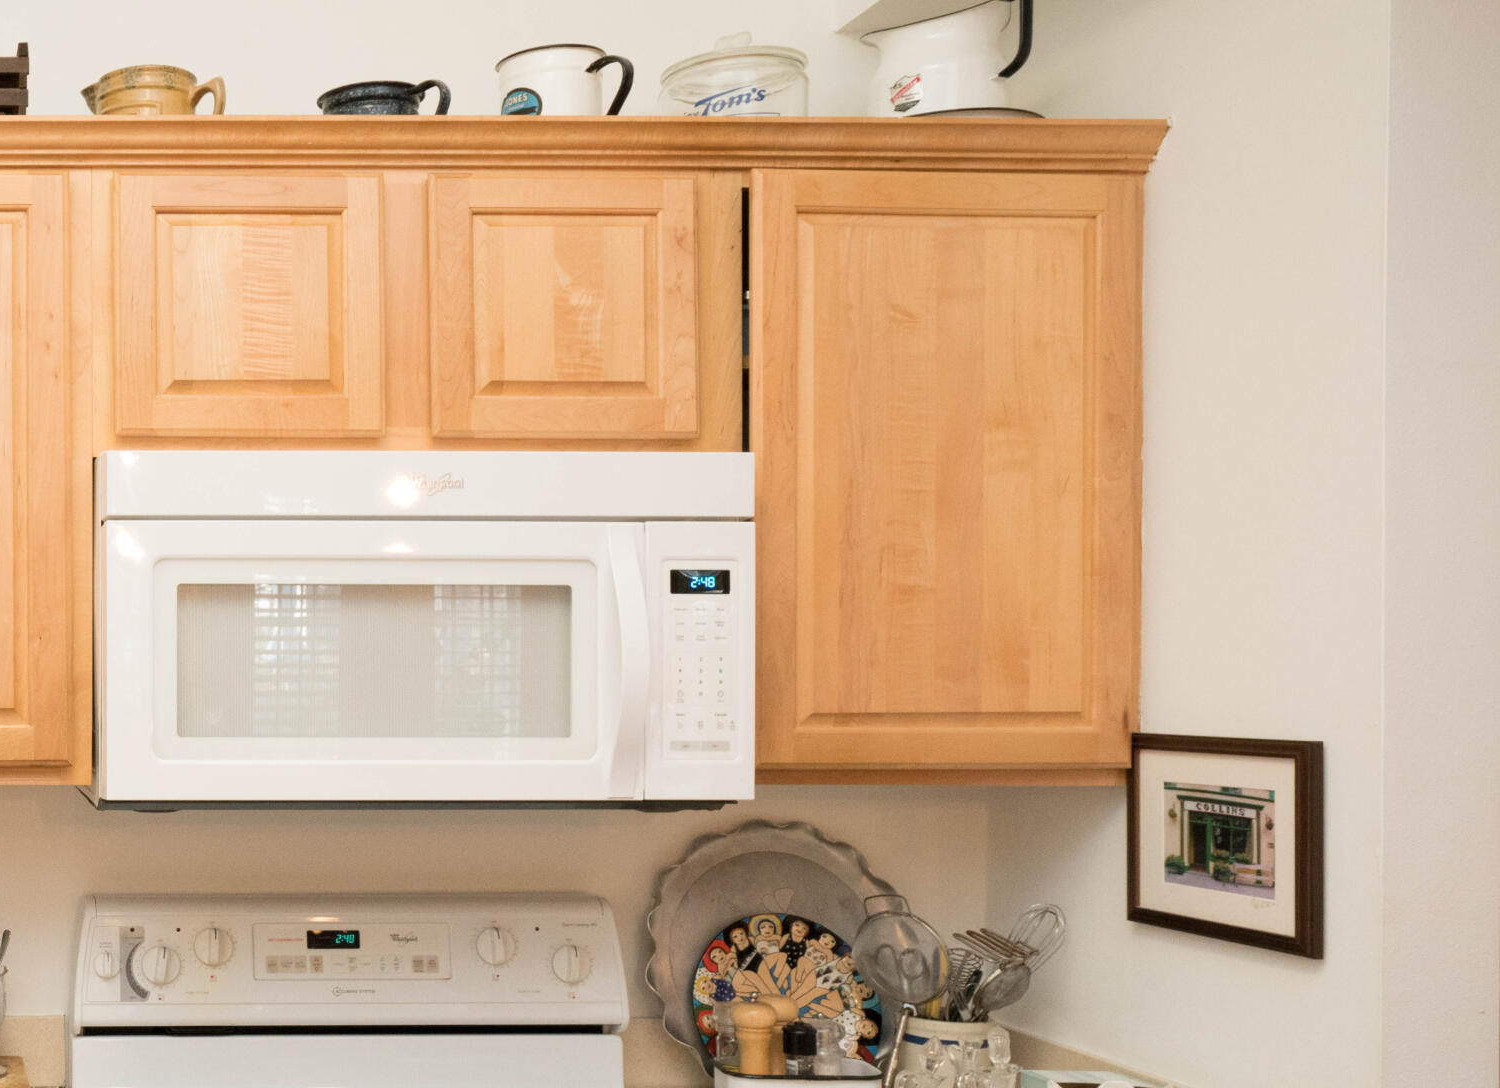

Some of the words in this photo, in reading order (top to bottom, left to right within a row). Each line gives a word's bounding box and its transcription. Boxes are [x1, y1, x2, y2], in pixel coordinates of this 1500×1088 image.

[690, 576, 716, 589] 2:48
[1195, 802, 1245, 816] COLLINS
[334, 934, 356, 944] 2:48
